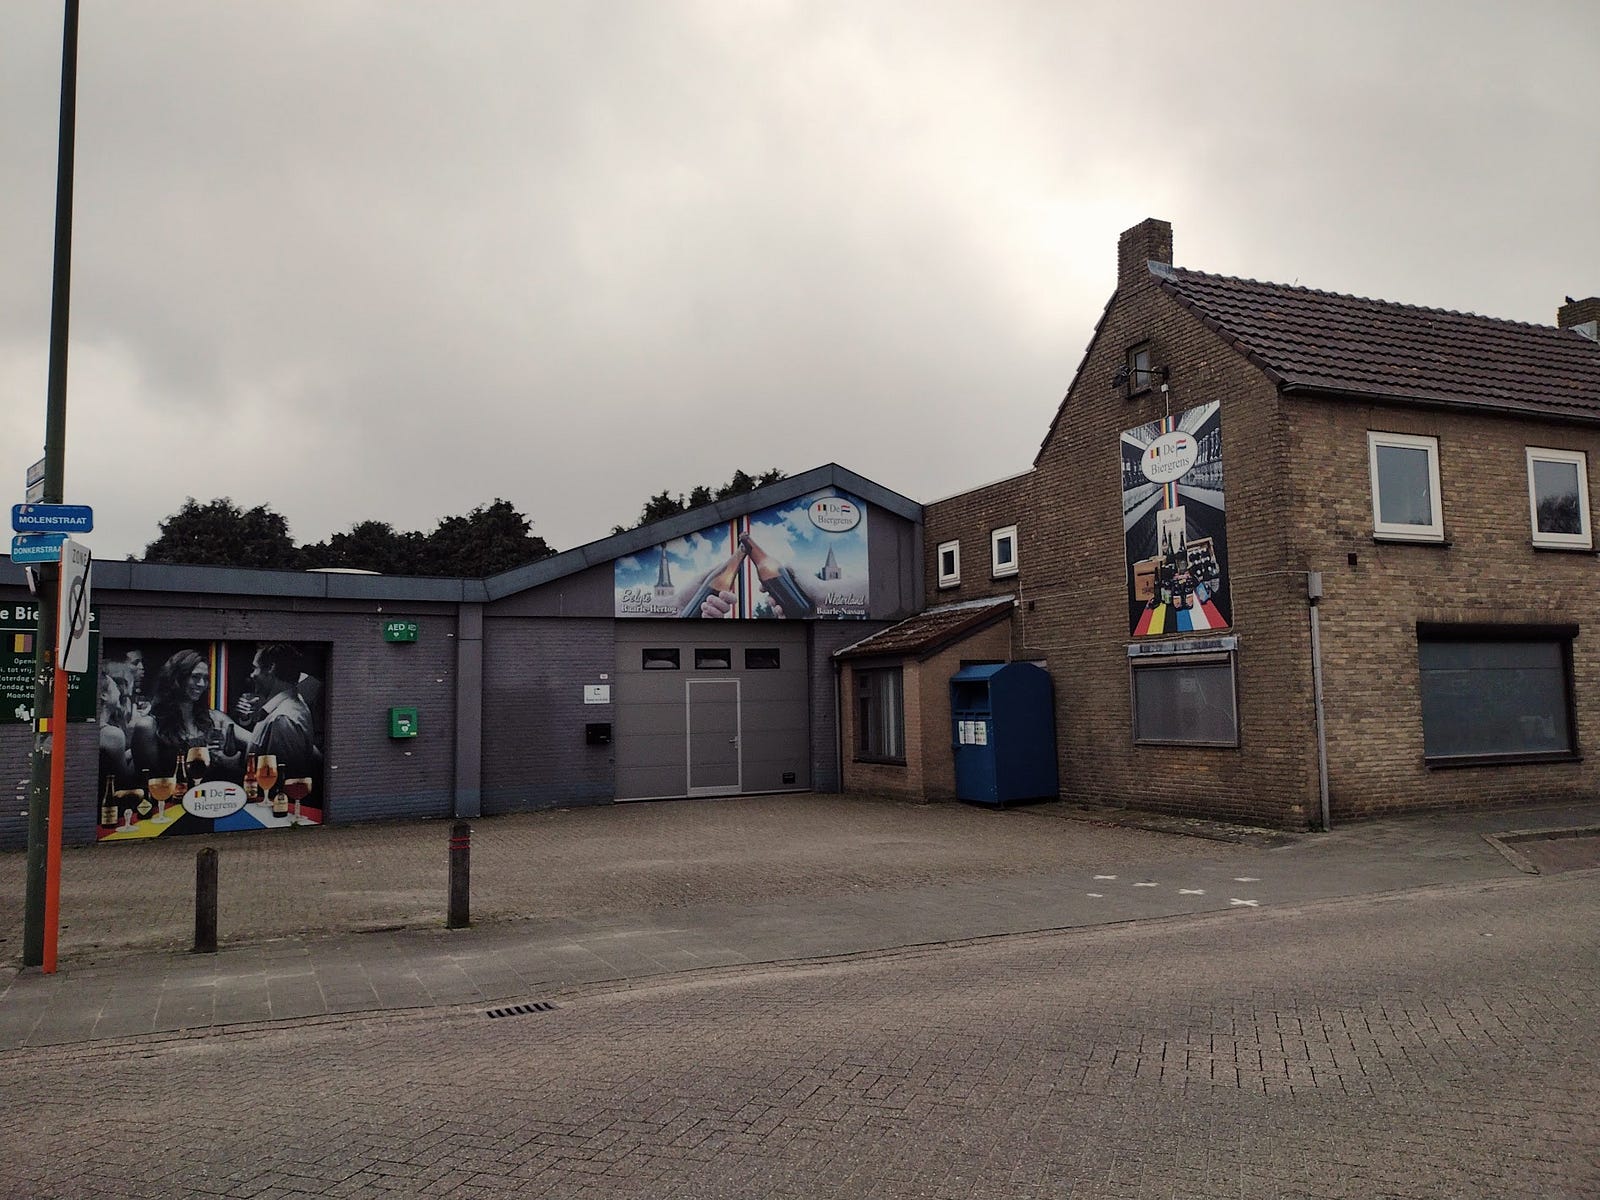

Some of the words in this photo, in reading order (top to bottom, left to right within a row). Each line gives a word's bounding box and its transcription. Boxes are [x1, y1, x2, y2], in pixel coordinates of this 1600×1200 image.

[1164, 444, 1175, 455] De
[1151, 457, 1190, 475] Biergrens
[830, 504, 840, 512] De
[18, 516, 87, 525] MOLENSTRAAT
[818, 515, 852, 526] Biergrens
[13, 546, 61, 555] DONKERSTRAA
[72, 549, 87, 567] ZONE
[824, 592, 865, 605] Nederland
[0, 609, 9, 620] e
[621, 605, 678, 615] Baarle-Hertog
[816, 607, 865, 615] Baarle-Nassau
[388, 623, 405, 631] AED
[0, 675, 30, 683] aterdag
[210, 789, 222, 798] De
[194, 801, 238, 812] Biergrens
